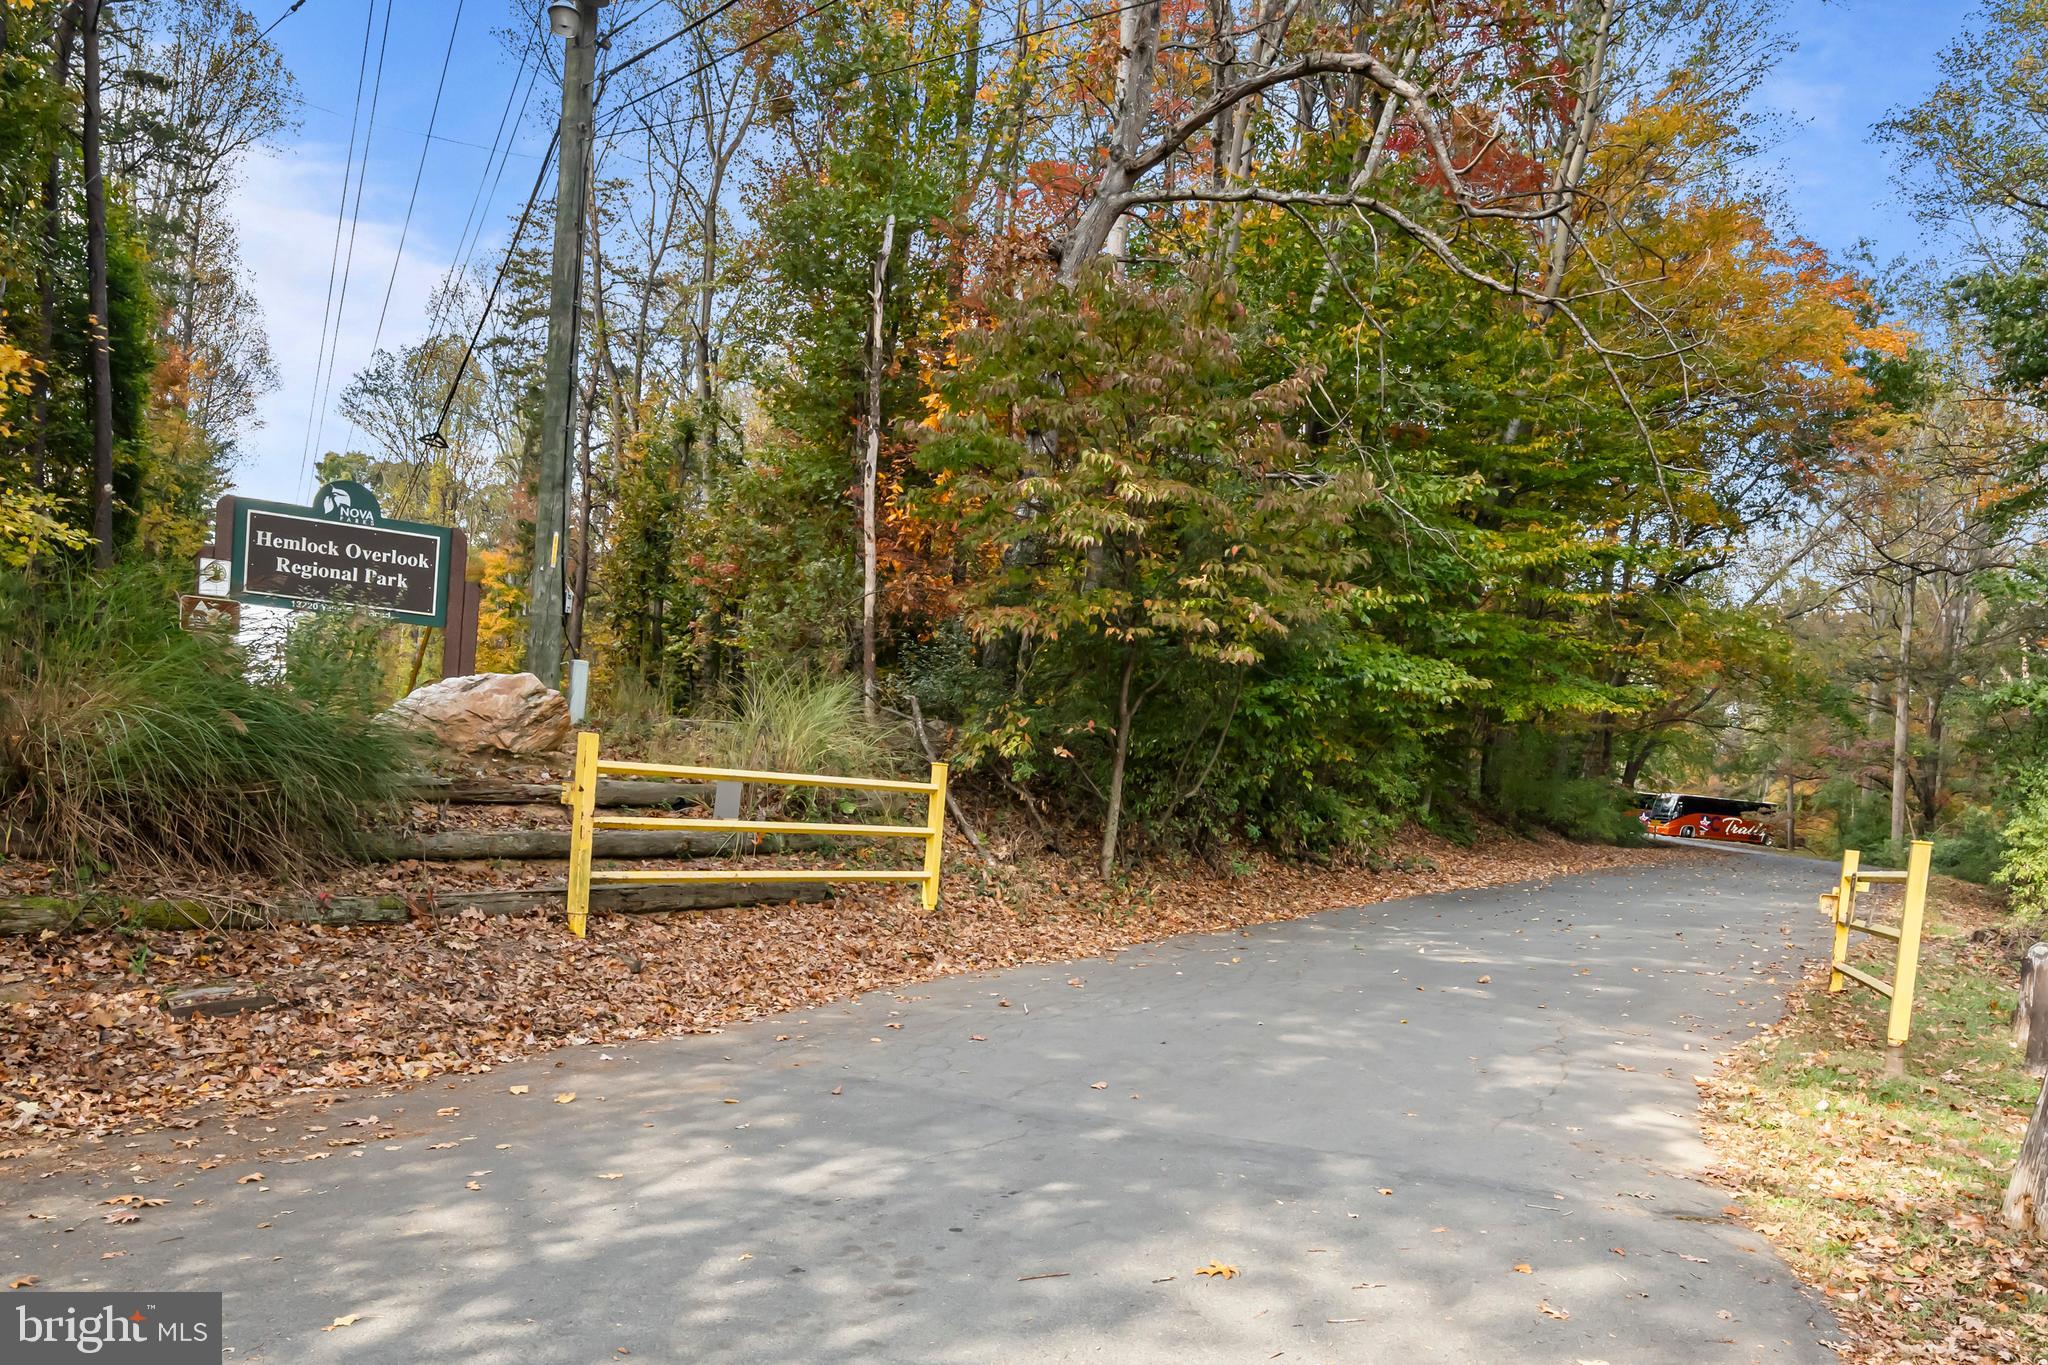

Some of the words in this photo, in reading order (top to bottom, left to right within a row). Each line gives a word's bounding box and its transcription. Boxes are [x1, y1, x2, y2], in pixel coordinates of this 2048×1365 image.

[340, 507, 374, 521] NOVA
[340, 516, 375, 527] PARKS
[256, 530, 339, 556] Hemlock
[345, 543, 429, 569] Overlook
[276, 556, 358, 582] Regional
[365, 567, 408, 589] Park
